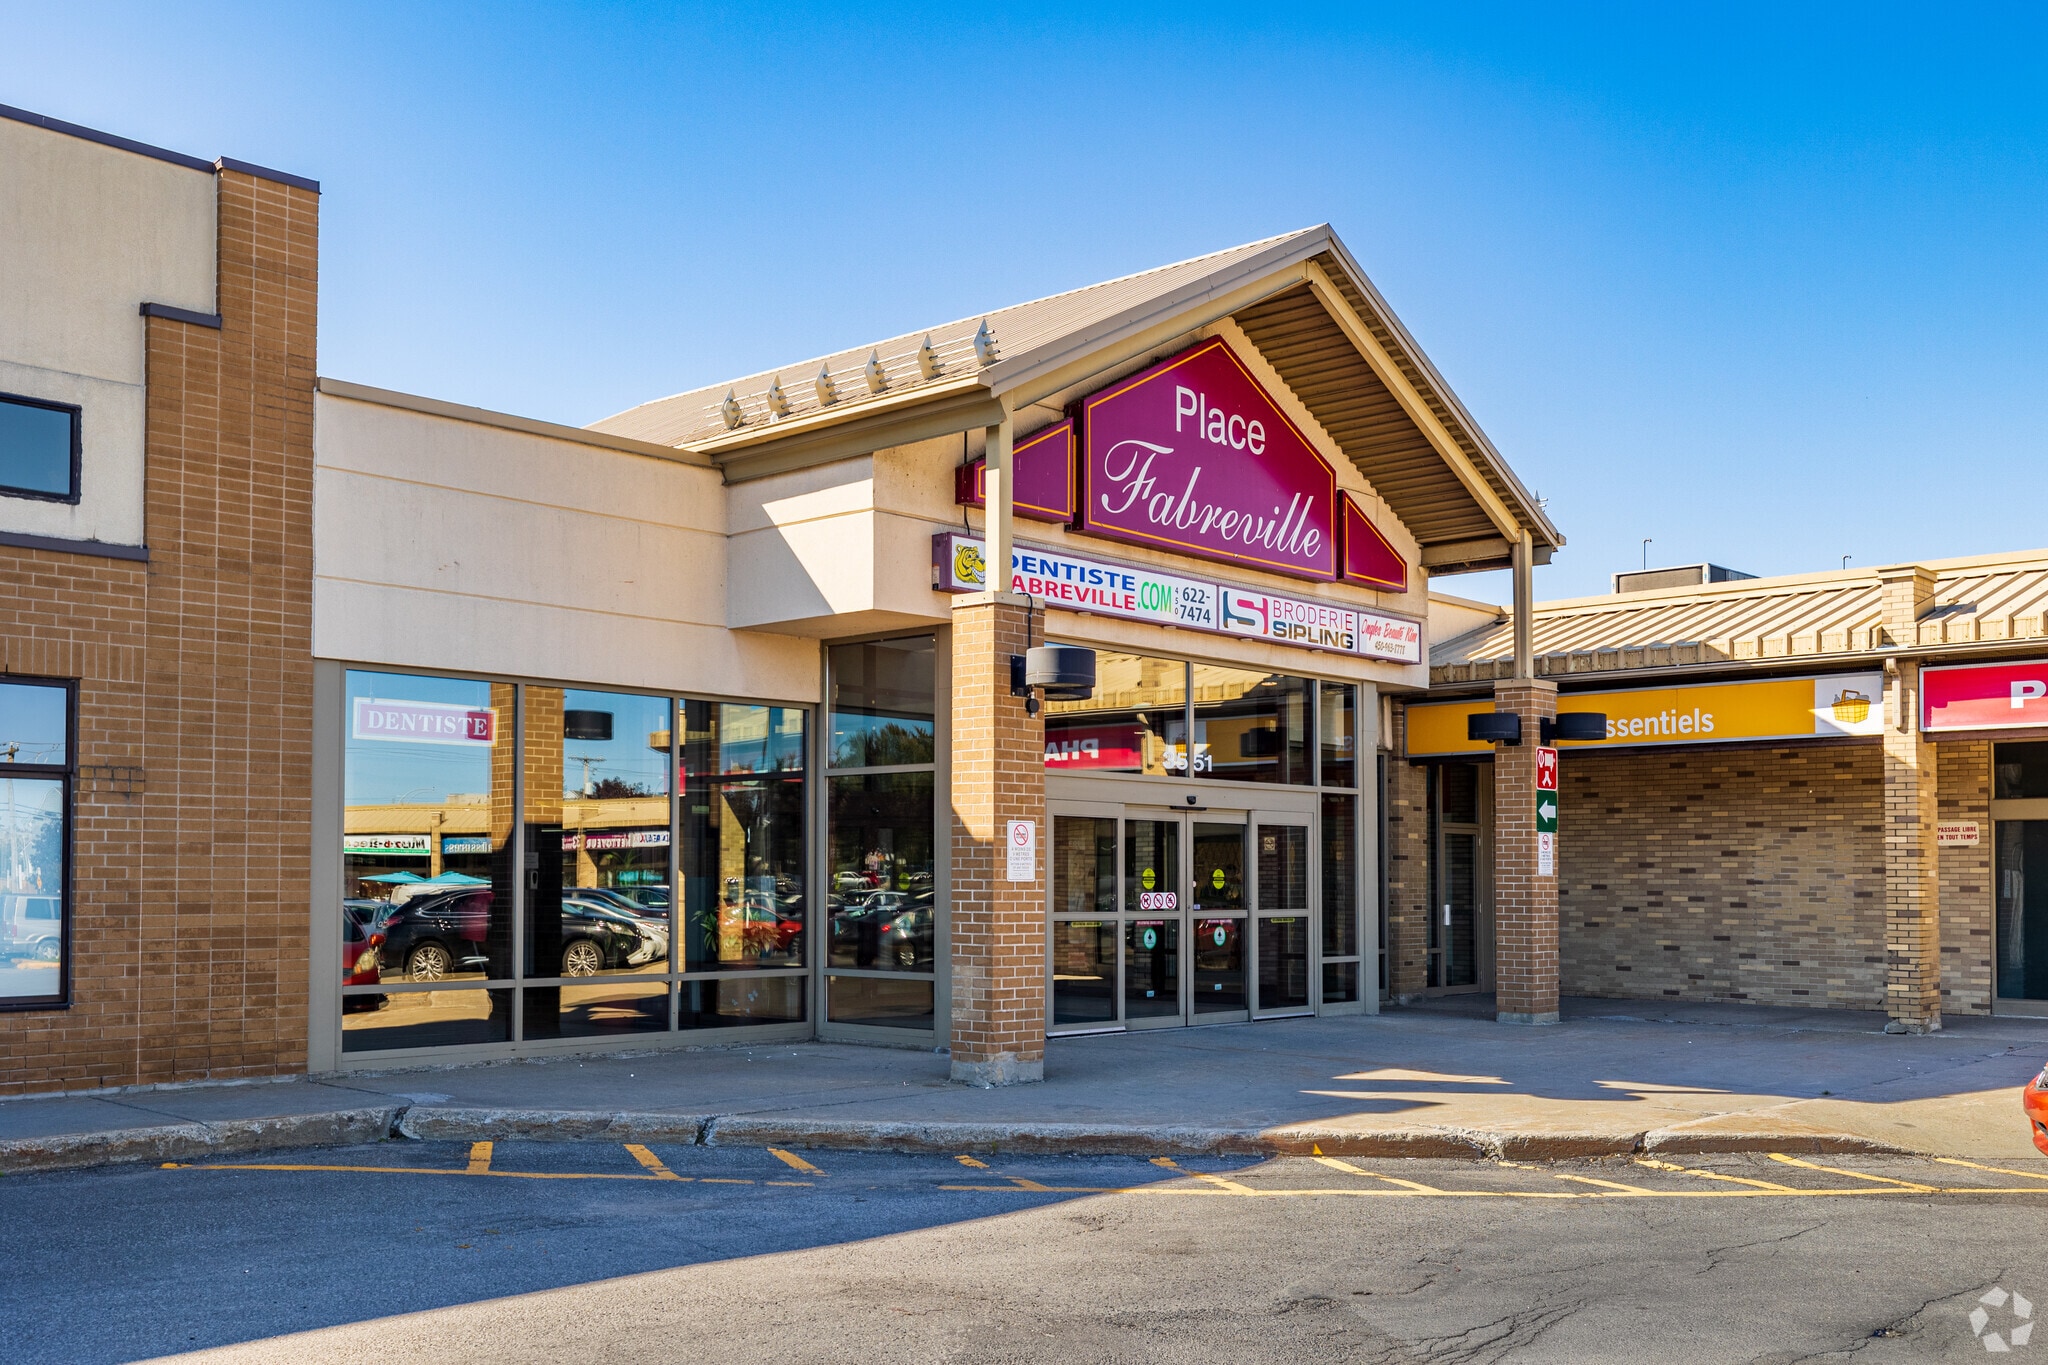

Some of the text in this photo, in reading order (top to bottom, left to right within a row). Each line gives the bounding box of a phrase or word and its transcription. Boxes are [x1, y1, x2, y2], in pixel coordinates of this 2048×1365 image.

[1175, 384, 1266, 455] Place
[1101, 439, 1321, 558] Fabreville
[1180, 604, 1211, 623] 7474
[1273, 600, 1353, 631] BRODERIE
[1273, 620, 1353, 650] SIPLING
[1361, 618, 1382, 641] Ongles
[2010, 680, 2047, 709] P
[367, 710, 488, 736] DENTISTE
[1606, 707, 1715, 738] ssentiels
